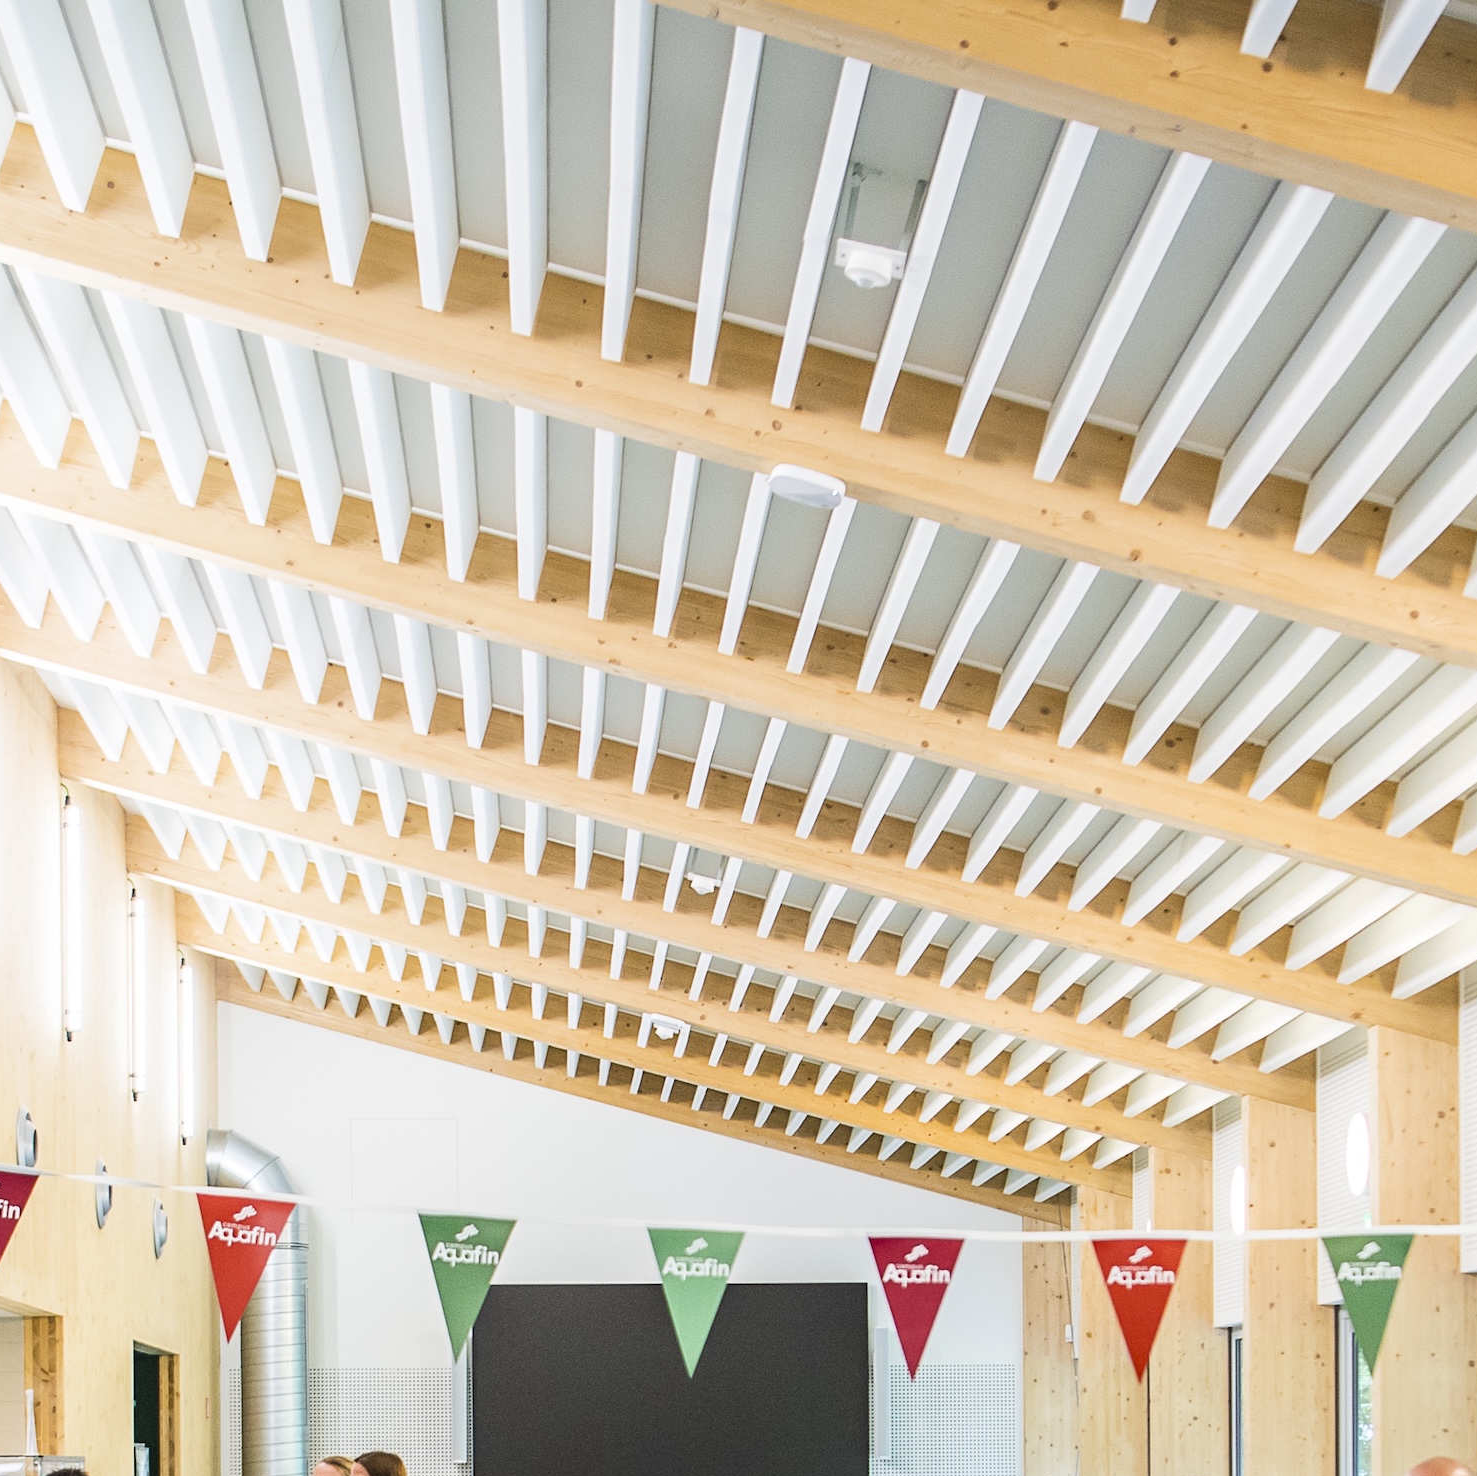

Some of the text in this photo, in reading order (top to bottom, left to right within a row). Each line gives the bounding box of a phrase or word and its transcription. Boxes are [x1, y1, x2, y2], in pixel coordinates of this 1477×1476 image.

[208, 1220, 277, 1246] Aquafin
[432, 1241, 500, 1267] Aquafin
[662, 1255, 730, 1280] Aquafin
[882, 1263, 951, 1288] Aquafin
[1106, 1265, 1176, 1290] Aquafin
[1337, 1261, 1403, 1287] Aquafin
